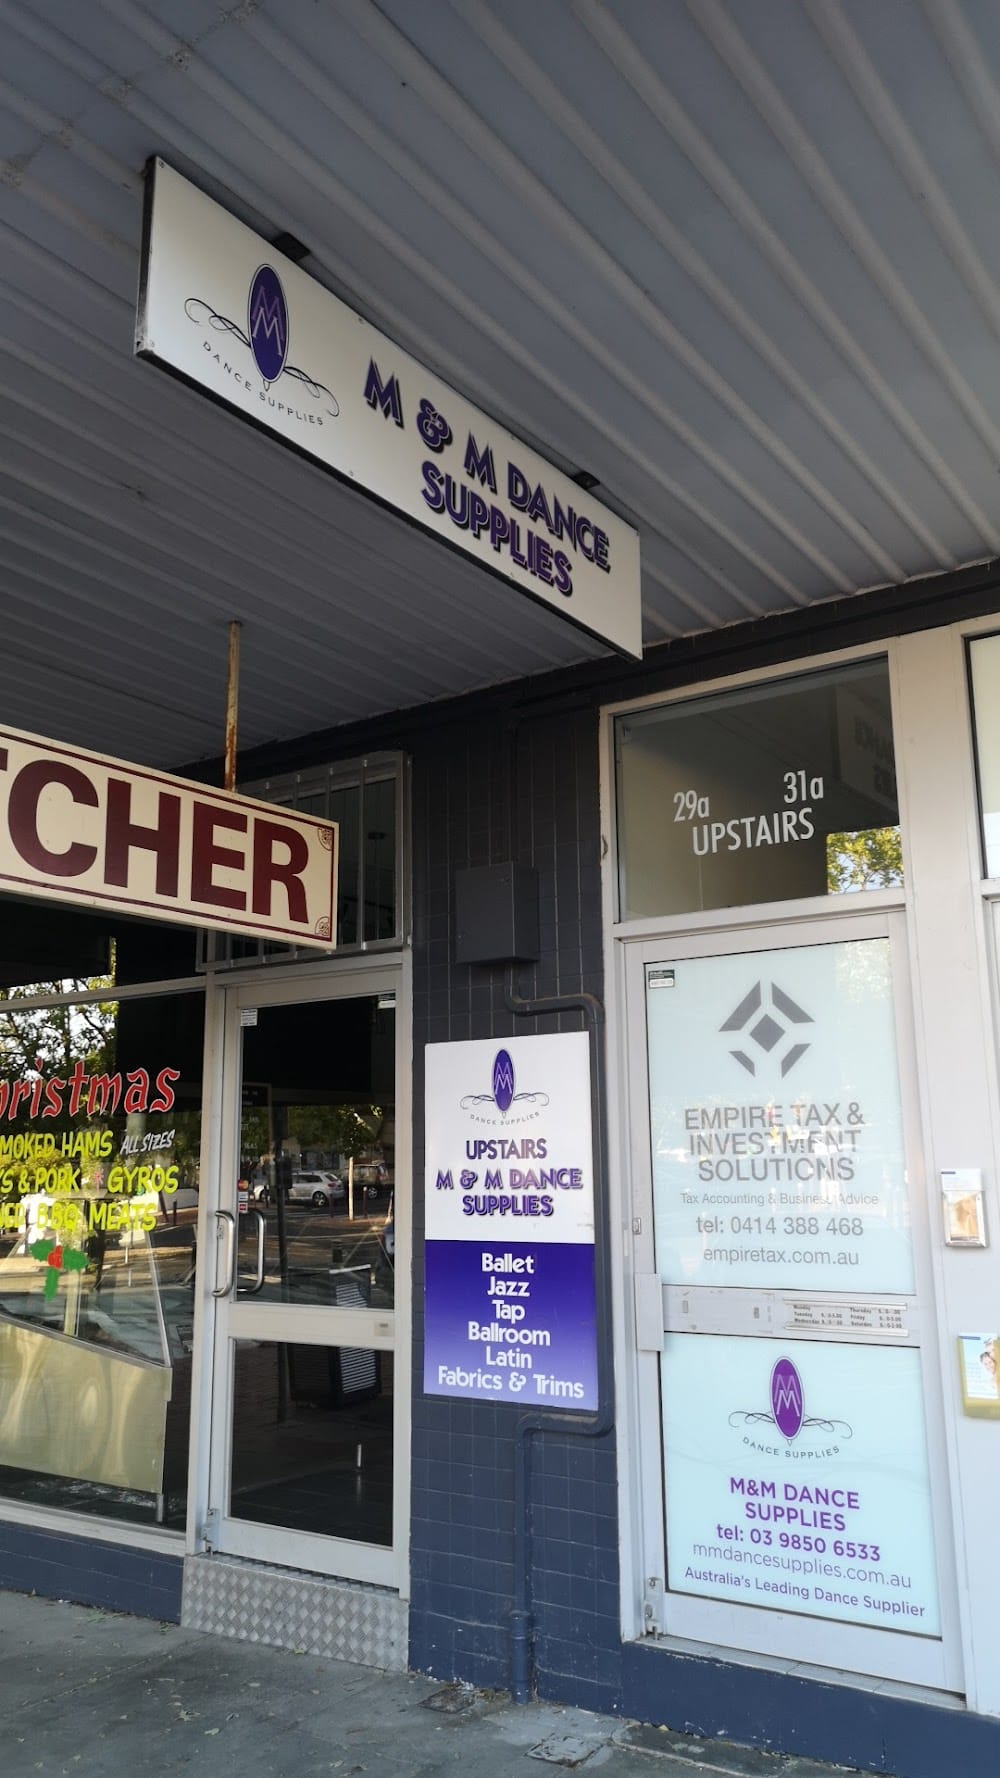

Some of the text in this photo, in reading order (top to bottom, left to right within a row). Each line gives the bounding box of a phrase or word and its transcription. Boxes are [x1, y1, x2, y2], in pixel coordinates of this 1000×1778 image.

[203, 340, 324, 426] DANCE SUPPLIES
[363, 356, 611, 574] M & M DANCE
[421, 461, 574, 597] SUPPLIES
[673, 770, 824, 822] 29a 31a
[0, 748, 309, 924] CHER
[692, 808, 815, 856] UPSTAIRS
[470, 1112, 540, 1126] DANCE SUPPLIES
[684, 1101, 865, 1130] EMPIRE TAX &
[61, 1130, 114, 1158] HAMS
[120, 1129, 176, 1154] ALL SIZES
[466, 1138, 548, 1160] UPSTAIRS
[690, 1130, 861, 1156] INVESTMENT
[18, 1169, 30, 1194] &
[35, 1167, 81, 1193] PORK
[107, 1165, 180, 1194] GYROS
[436, 1168, 583, 1190] M & M DANCE
[699, 1157, 855, 1182] SOLUTIONS
[462, 1194, 554, 1216] SUPPLIES
[680, 1192, 699, 1205] Tax
[702, 1192, 765, 1207] Accounting
[768, 1193, 776, 1205] &
[838, 1192, 879, 1205] Advice
[89, 1202, 157, 1231] MEATS
[696, 1216, 864, 1237] tel: 0414 388 468
[481, 1253, 535, 1274] Ballet
[704, 1247, 859, 1266] empiretax.com.au
[487, 1276, 530, 1297] Jazz
[492, 1299, 526, 1324] Tap
[468, 1321, 550, 1346] Ballroom
[486, 1346, 532, 1369] Latin
[438, 1366, 584, 1399] Fabrics & Trims
[742, 1436, 841, 1459] DANCE SUPPLIES
[730, 1477, 859, 1510] M&M DANCE
[745, 1502, 846, 1531] SUPPLIES
[716, 1524, 881, 1562] tel: 03 9850 6533
[693, 1542, 912, 1589] mmdancesupplies.com.au
[684, 1566, 925, 1617] Australia's Leading Dance Supplier
